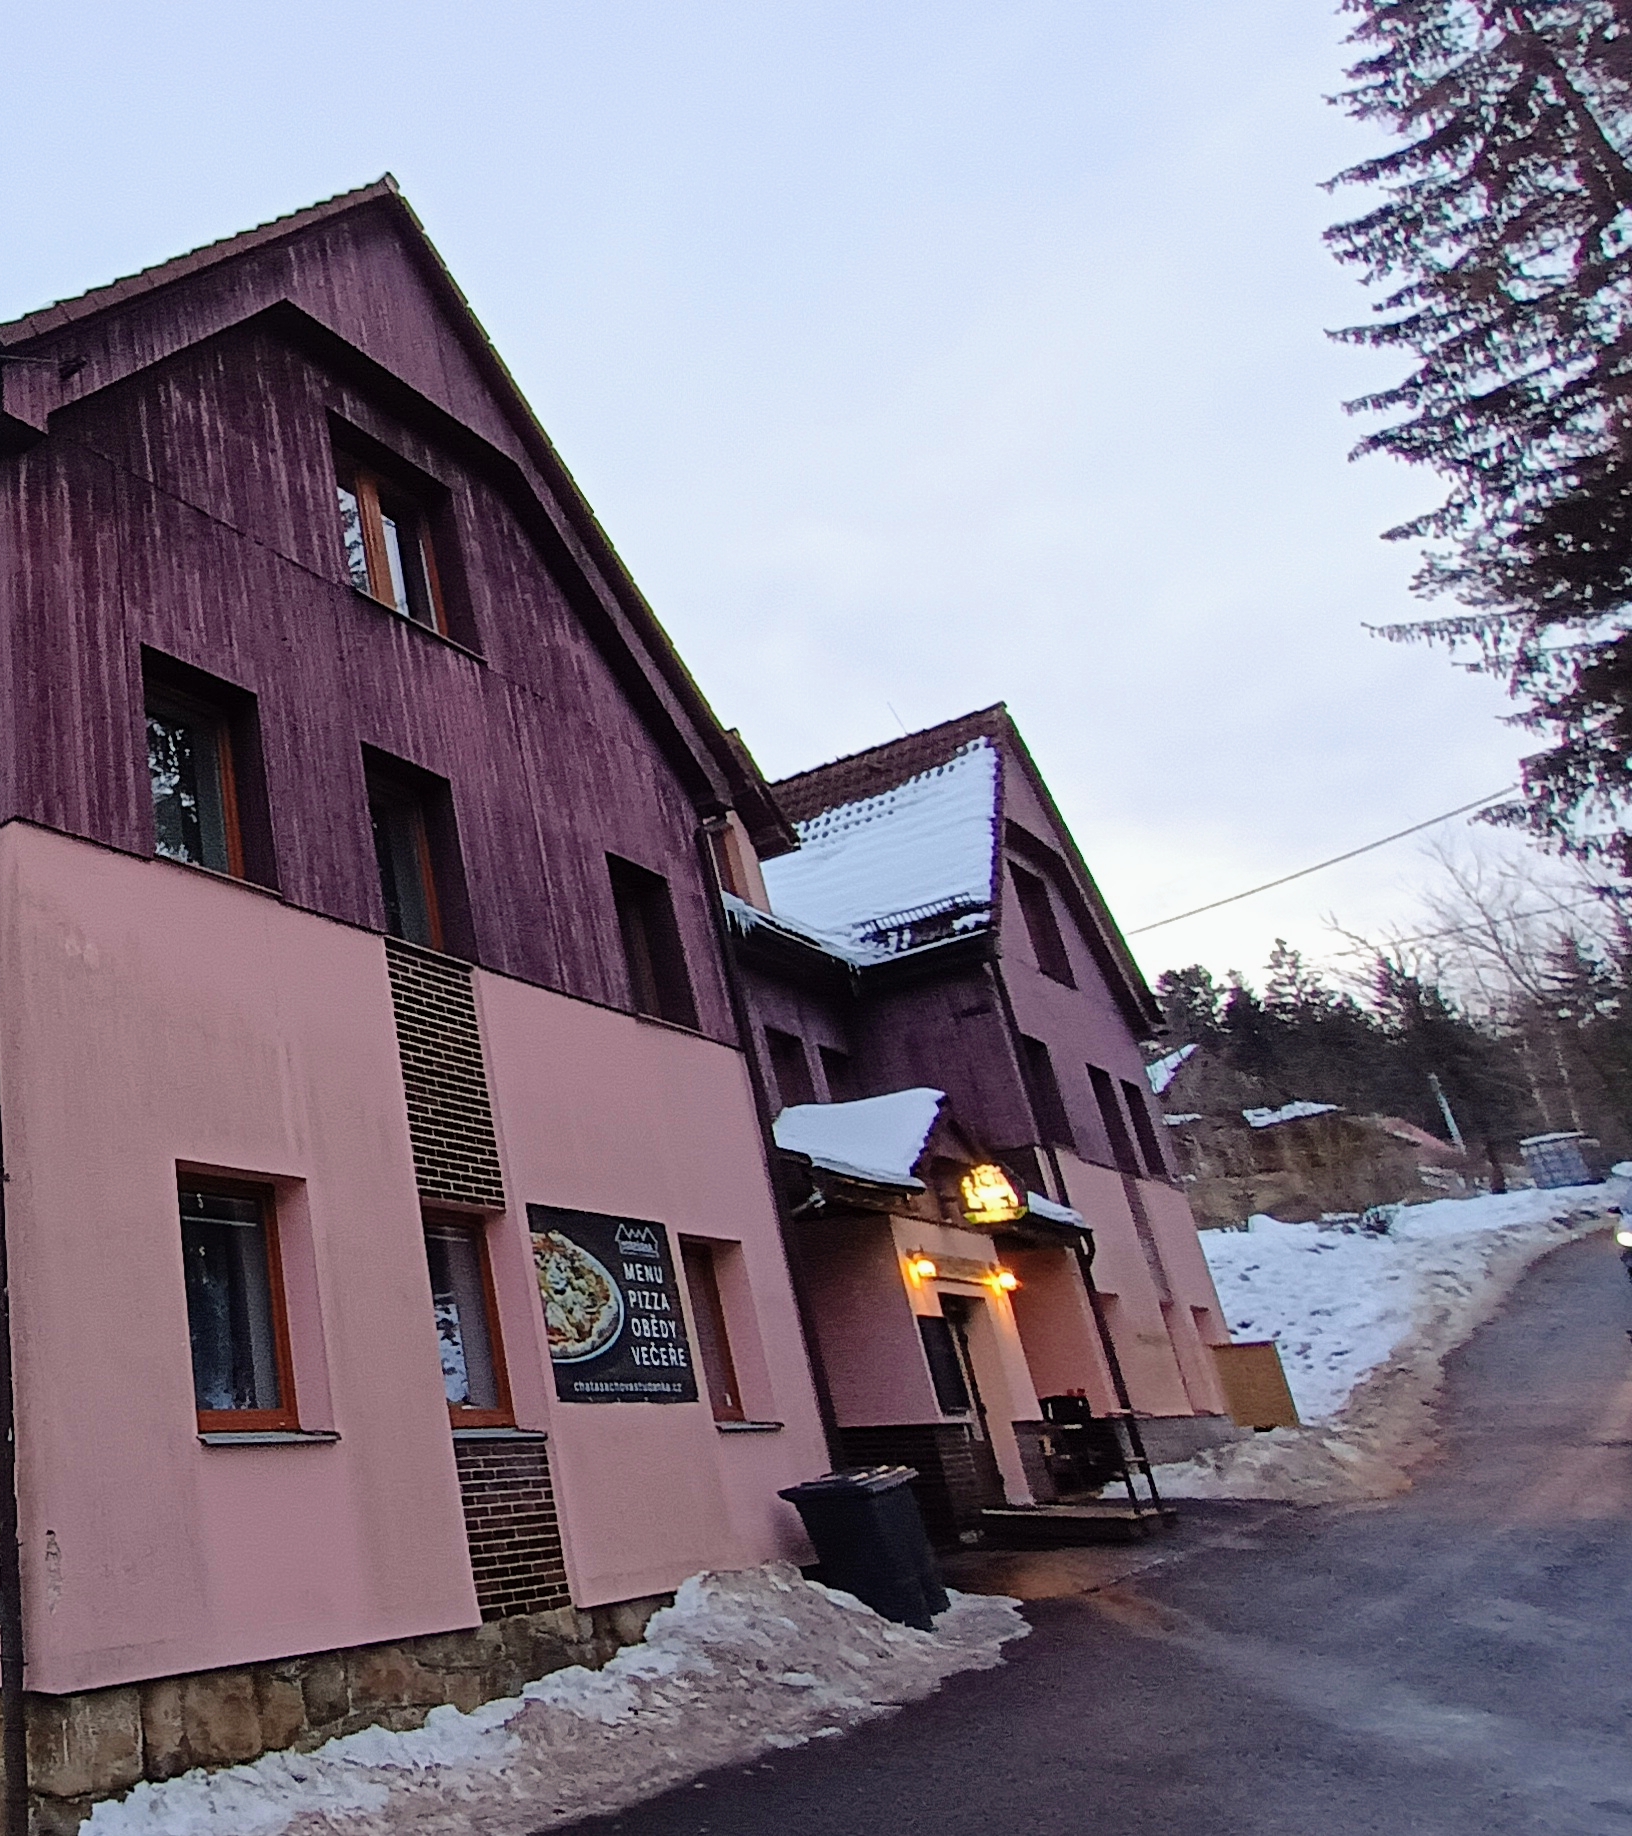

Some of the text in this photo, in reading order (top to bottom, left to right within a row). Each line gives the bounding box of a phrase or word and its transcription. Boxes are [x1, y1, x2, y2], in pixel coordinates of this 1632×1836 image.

[623, 1262, 663, 1284] MENU
[628, 1290, 670, 1311] PIZZA
[631, 1313, 677, 1338] OBĚDY
[631, 1342, 688, 1367] VEČEŘE
